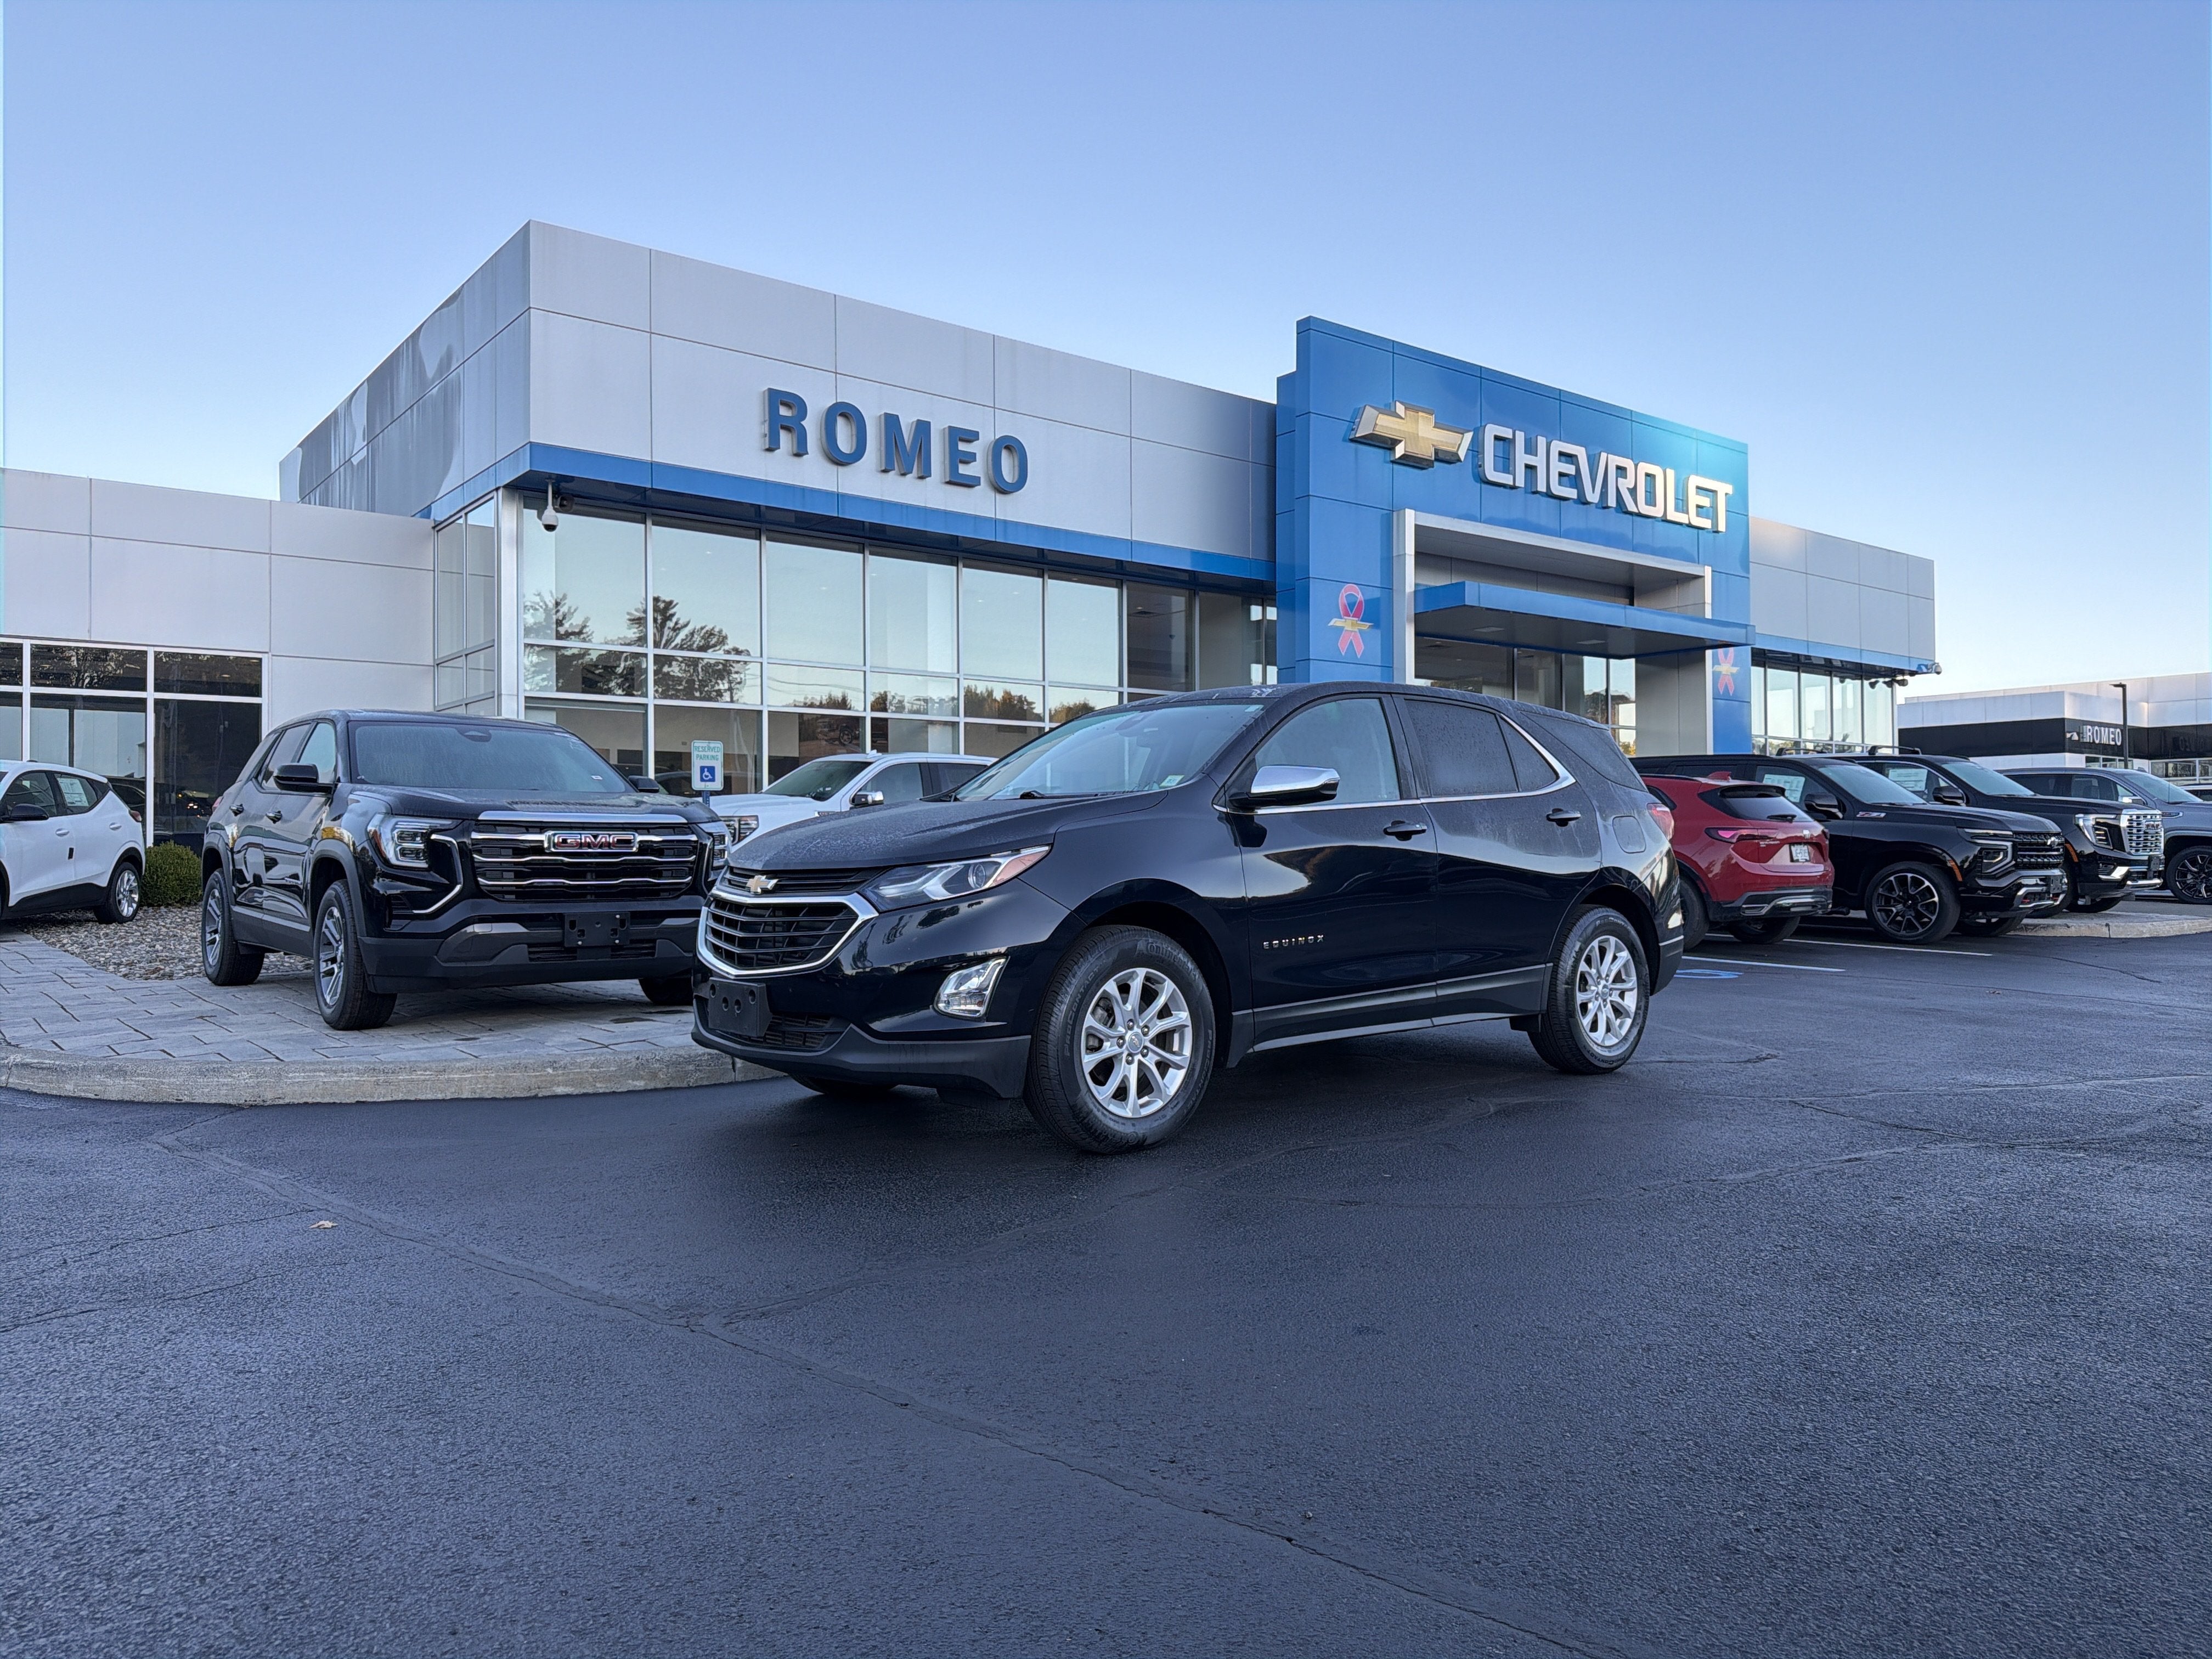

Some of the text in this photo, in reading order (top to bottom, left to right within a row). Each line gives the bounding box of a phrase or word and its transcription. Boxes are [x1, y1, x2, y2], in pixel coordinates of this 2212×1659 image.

[764, 387, 1028, 494] ROMEO
[1481, 423, 1733, 533] CHEVROLET
[2086, 725, 2122, 746] ROMEO
[555, 834, 635, 849] GMC
[1263, 935, 1324, 949] EQUINOX
